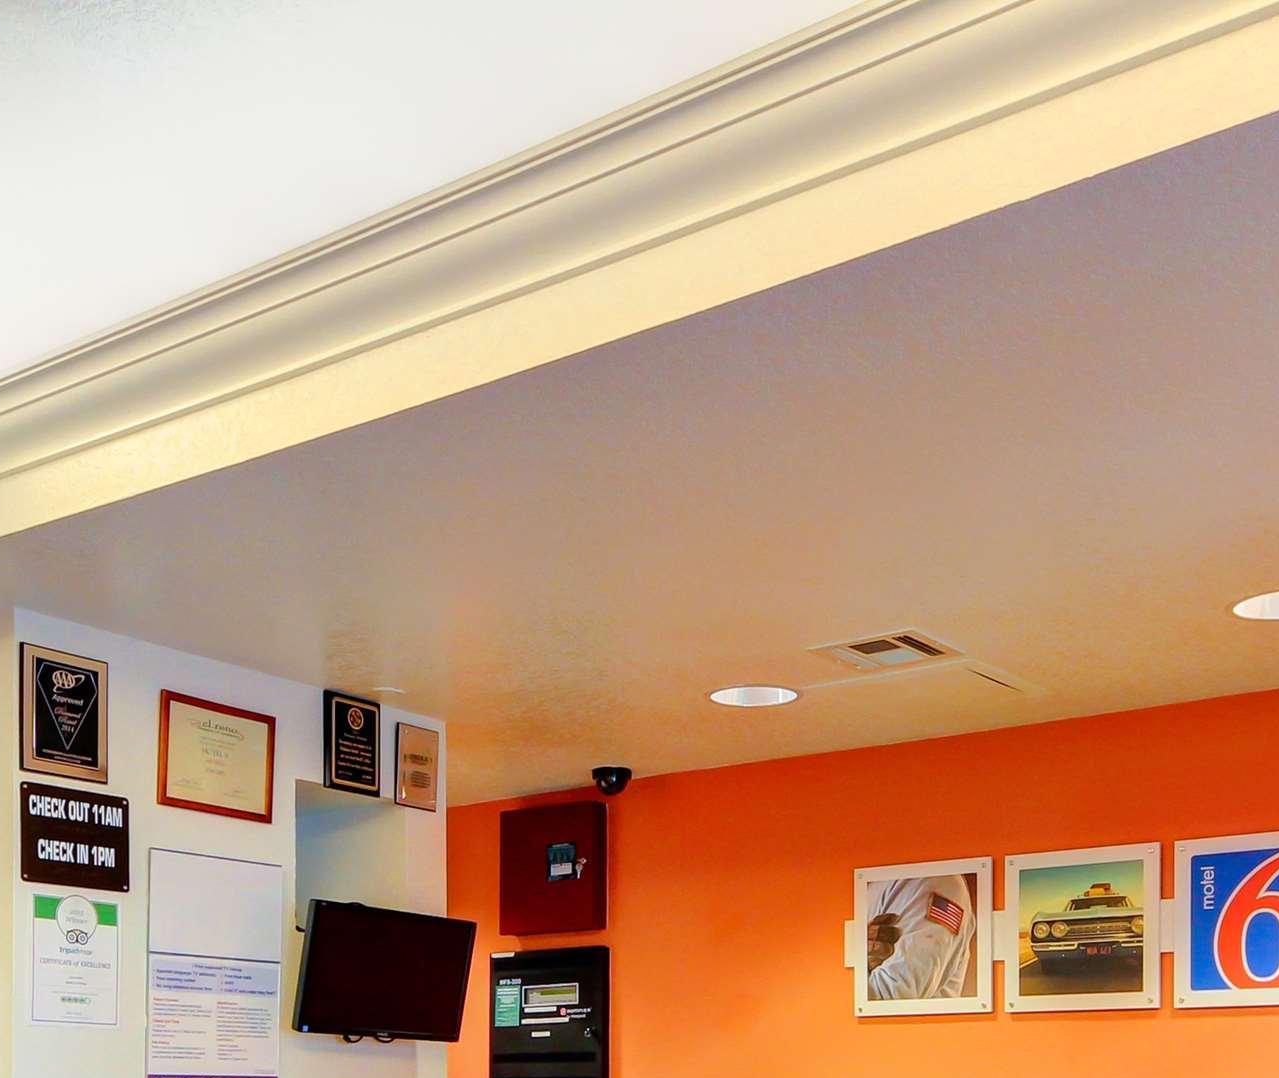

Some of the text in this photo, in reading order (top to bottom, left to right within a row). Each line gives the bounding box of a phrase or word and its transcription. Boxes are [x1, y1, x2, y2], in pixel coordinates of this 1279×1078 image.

[29, 794, 123, 827] CHECK OUT 11AM
[37, 838, 115, 868] CHECK IN 1PM
[1200, 866, 1215, 909] motel
